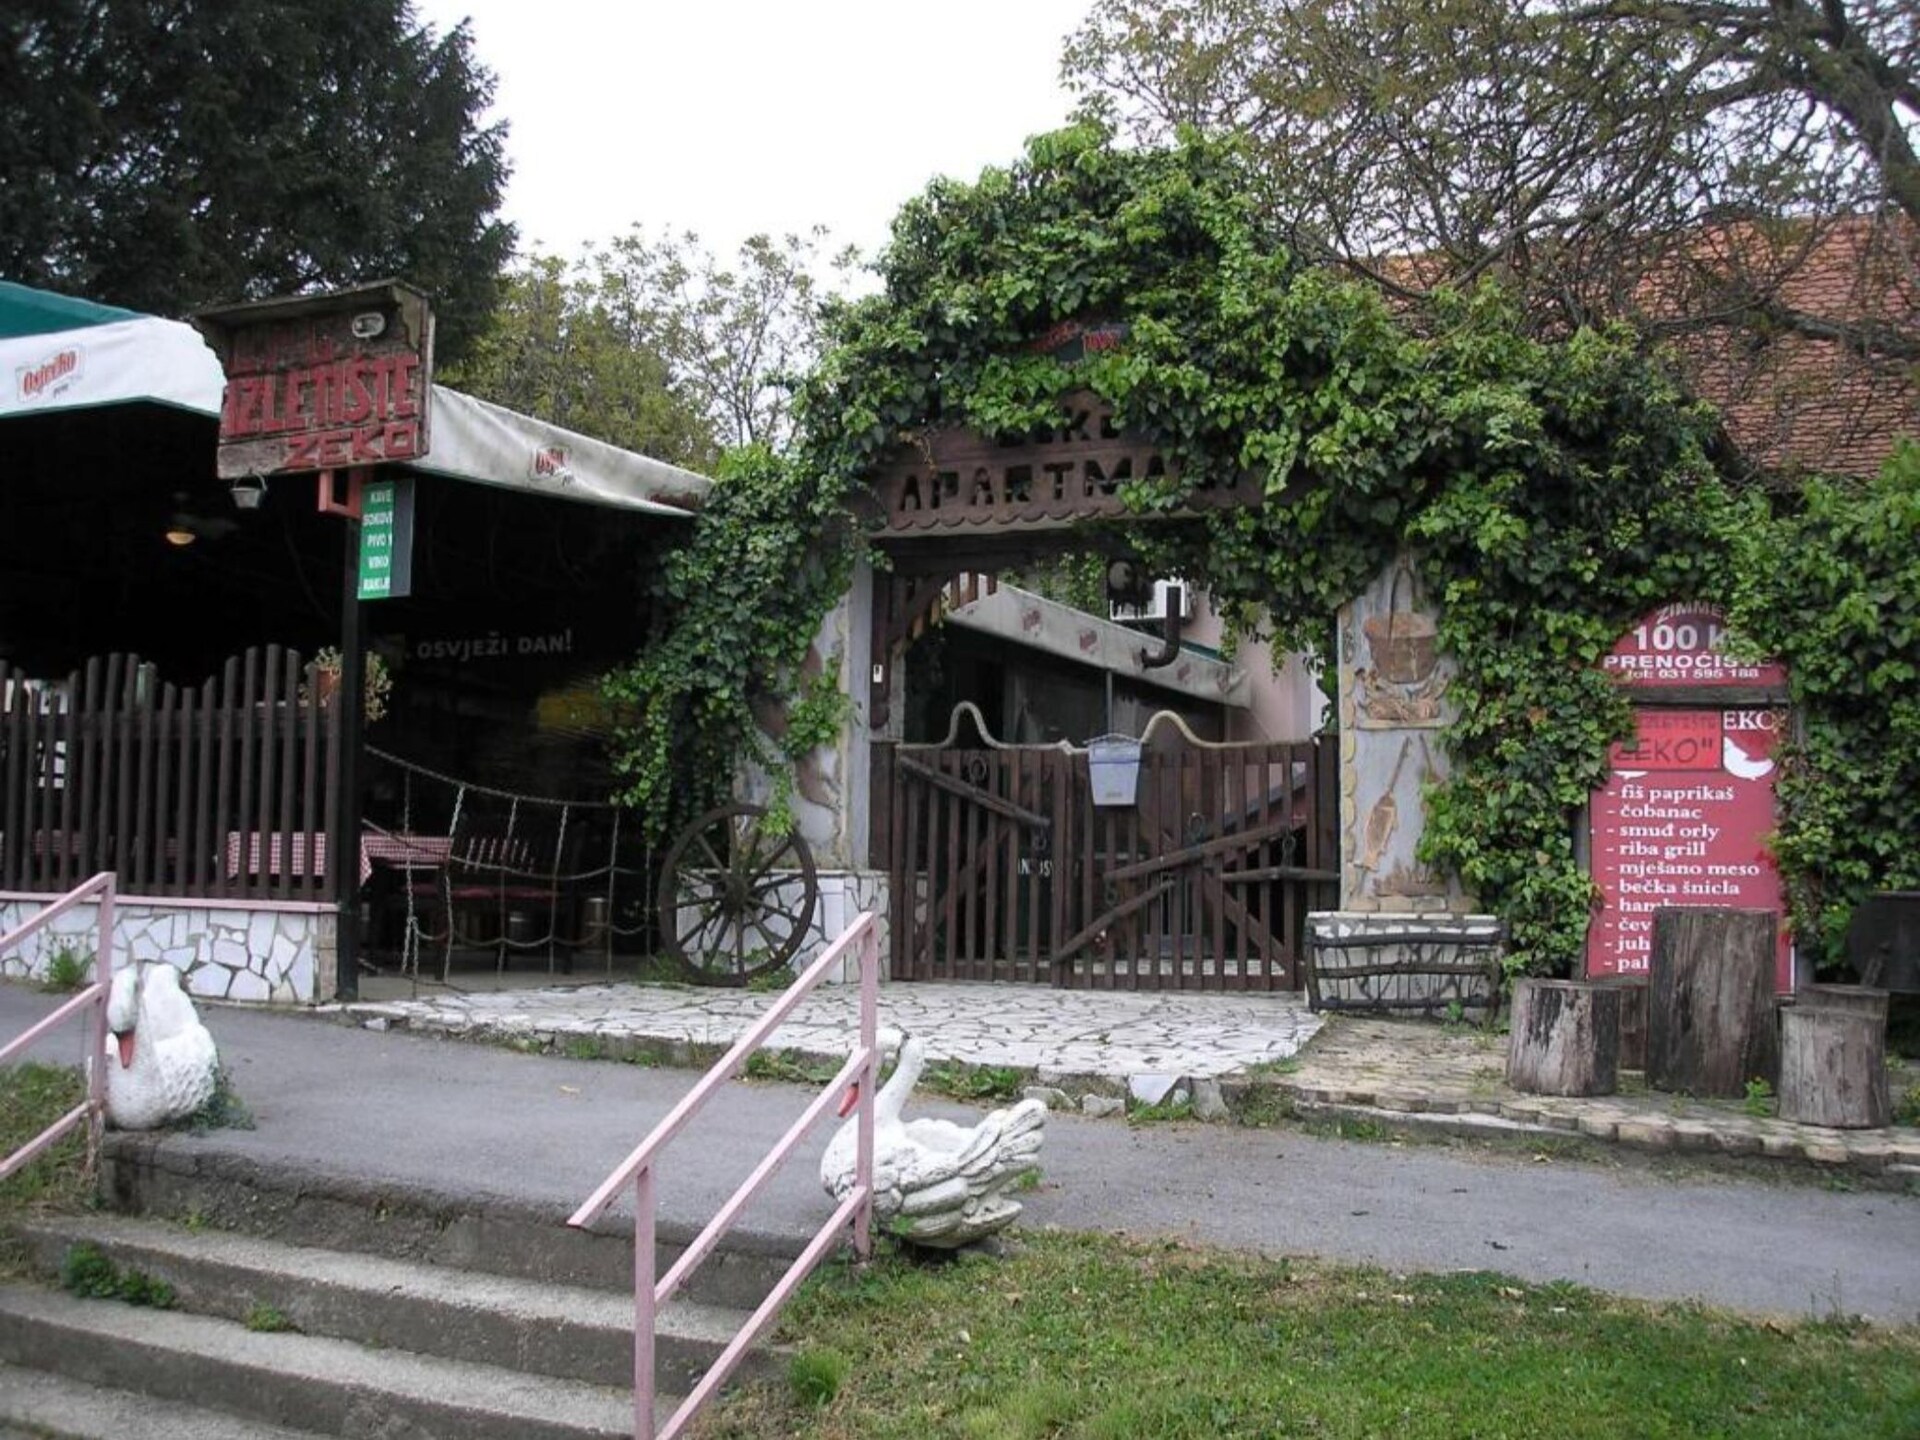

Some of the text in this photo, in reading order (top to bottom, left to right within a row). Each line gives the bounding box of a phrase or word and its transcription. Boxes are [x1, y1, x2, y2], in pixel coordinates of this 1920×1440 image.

[284, 423, 417, 469] ZEKO
[899, 455, 1237, 511] APARTMA
[1656, 600, 1726, 625] ZIMME
[417, 628, 572, 662] OSVJEŽI DAN!
[1632, 625, 1698, 651] 100
[1658, 669, 1687, 679] 031
[1649, 785, 1734, 803] paprikaš
[1620, 804, 1702, 819] čobanac
[1679, 824, 1720, 842] orly
[1619, 841, 1706, 859] riba grill
[1619, 859, 1760, 877] mješano meso
[1619, 879, 1677, 894] bečka
[1617, 917, 1652, 931] čev
[1615, 936, 1651, 954] juh
[1617, 955, 1649, 973] pal
